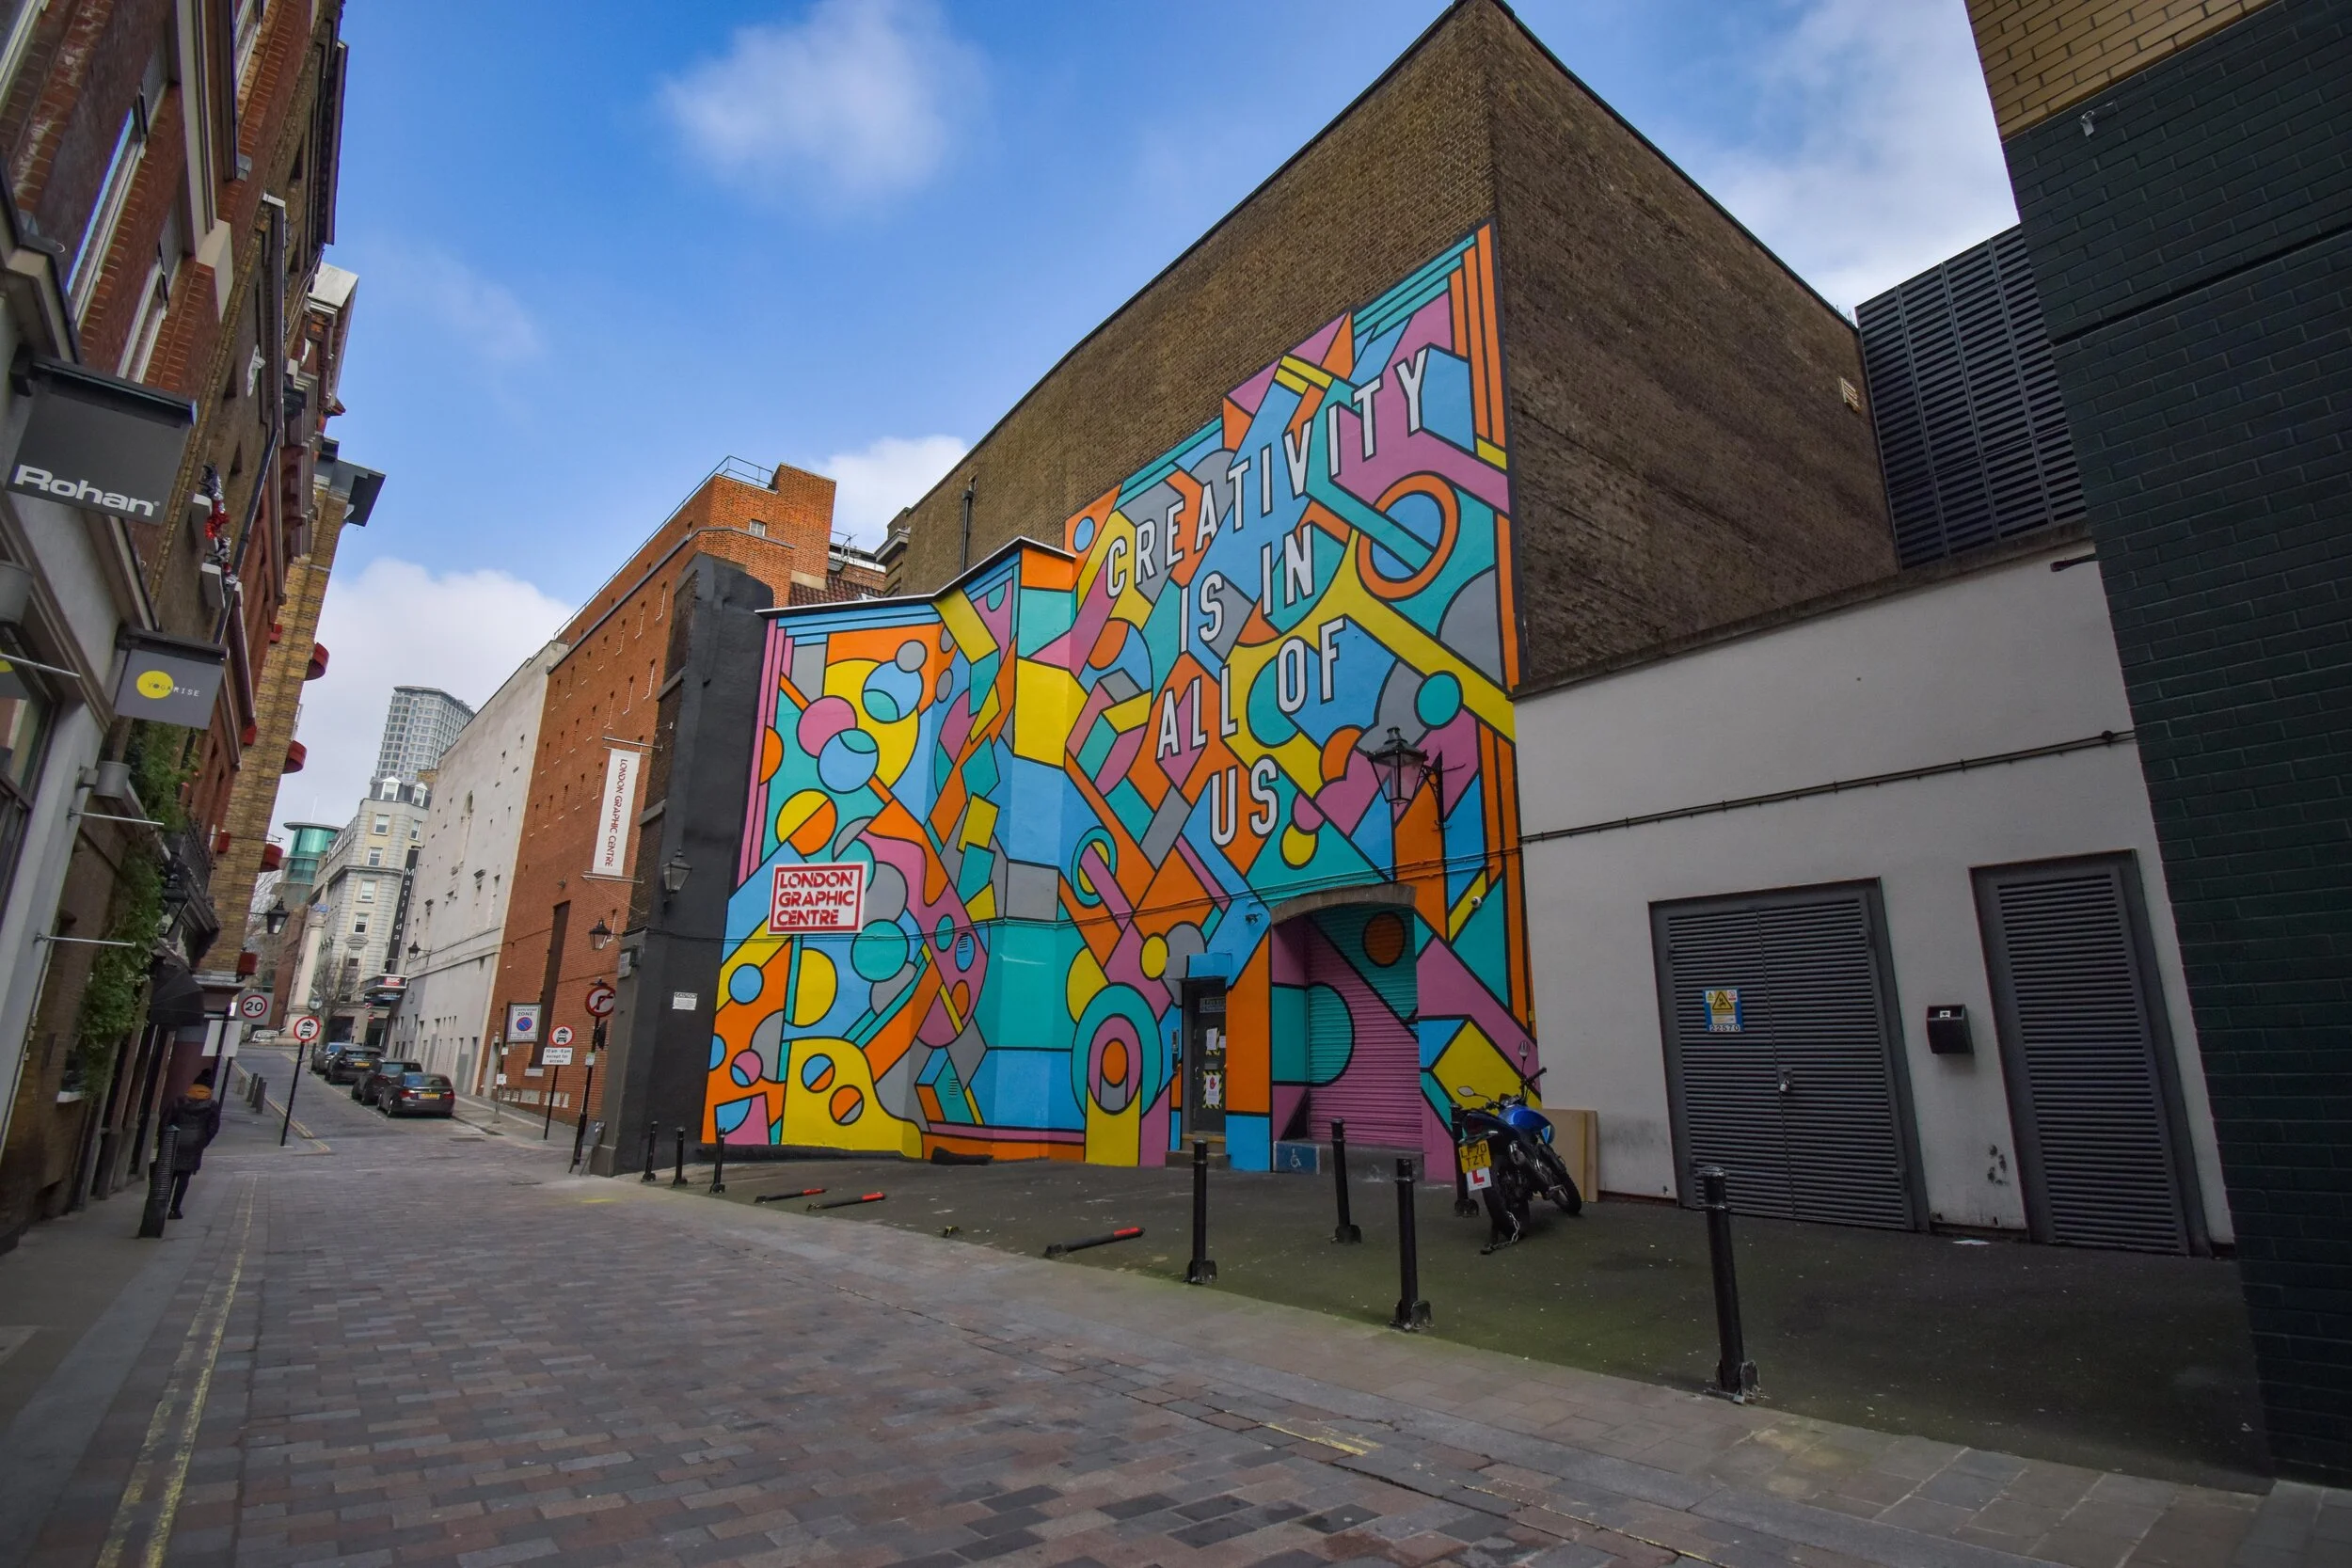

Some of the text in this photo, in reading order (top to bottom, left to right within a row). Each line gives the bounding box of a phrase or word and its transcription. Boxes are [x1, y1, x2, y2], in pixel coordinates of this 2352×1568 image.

[14, 464, 154, 516] Rohan
[1105, 344, 1430, 598] CREATIVITY
[1179, 523, 1313, 653] IS IN
[1157, 616, 1345, 760] ALL OF
[605, 758, 628, 867] LONDON GRAPHIC CENTRE
[1209, 757, 1279, 846] US
[393, 867, 415, 941] Matilda
[778, 890, 855, 908] GRAPHIC
[780, 871, 853, 889] LONDON
[776, 909, 839, 926] CENTRE
[245, 1001, 263, 1012] 20
[1472, 1169, 1486, 1184] L
